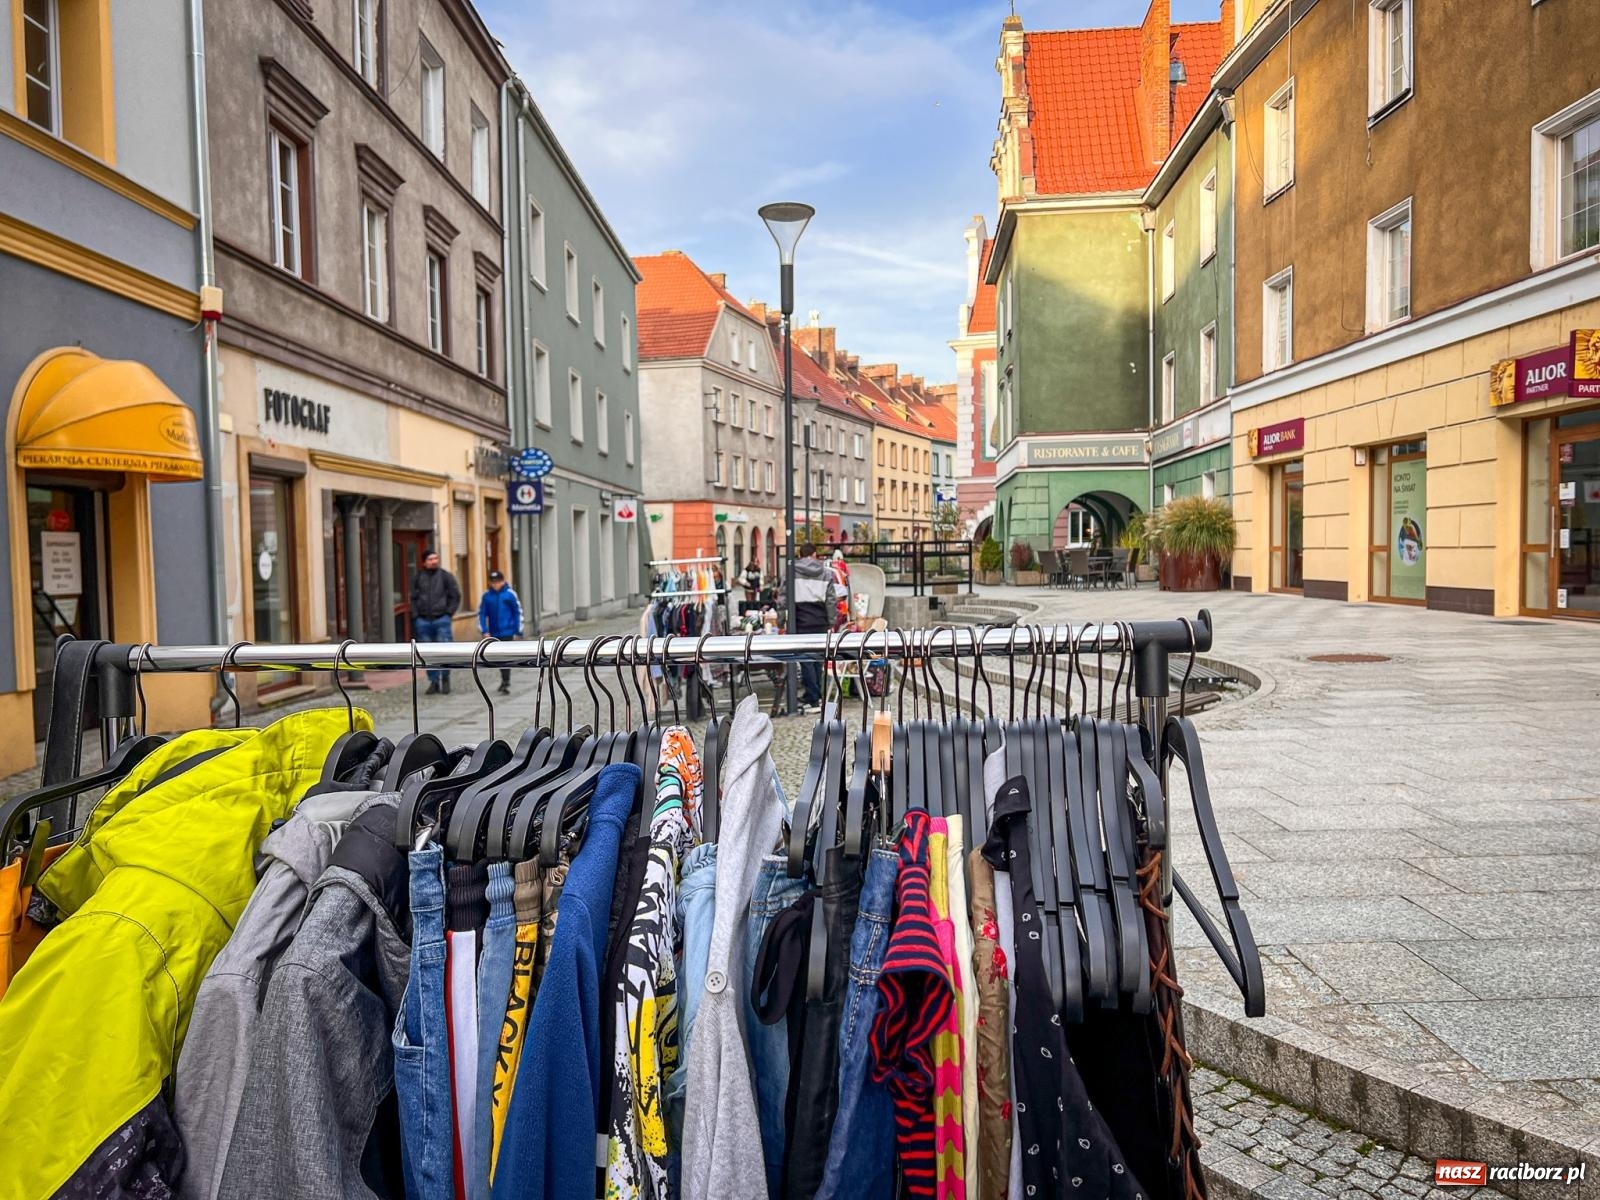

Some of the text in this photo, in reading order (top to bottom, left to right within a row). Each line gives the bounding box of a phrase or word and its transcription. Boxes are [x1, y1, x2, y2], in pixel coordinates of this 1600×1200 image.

[1525, 362, 1567, 386] ALIOR
[1526, 384, 1549, 394] PARTNER
[263, 388, 331, 435] FOTOGRAF
[1263, 429, 1296, 445] ALIOR BANK
[1033, 445, 1139, 459] RISTORANTE & CAFE
